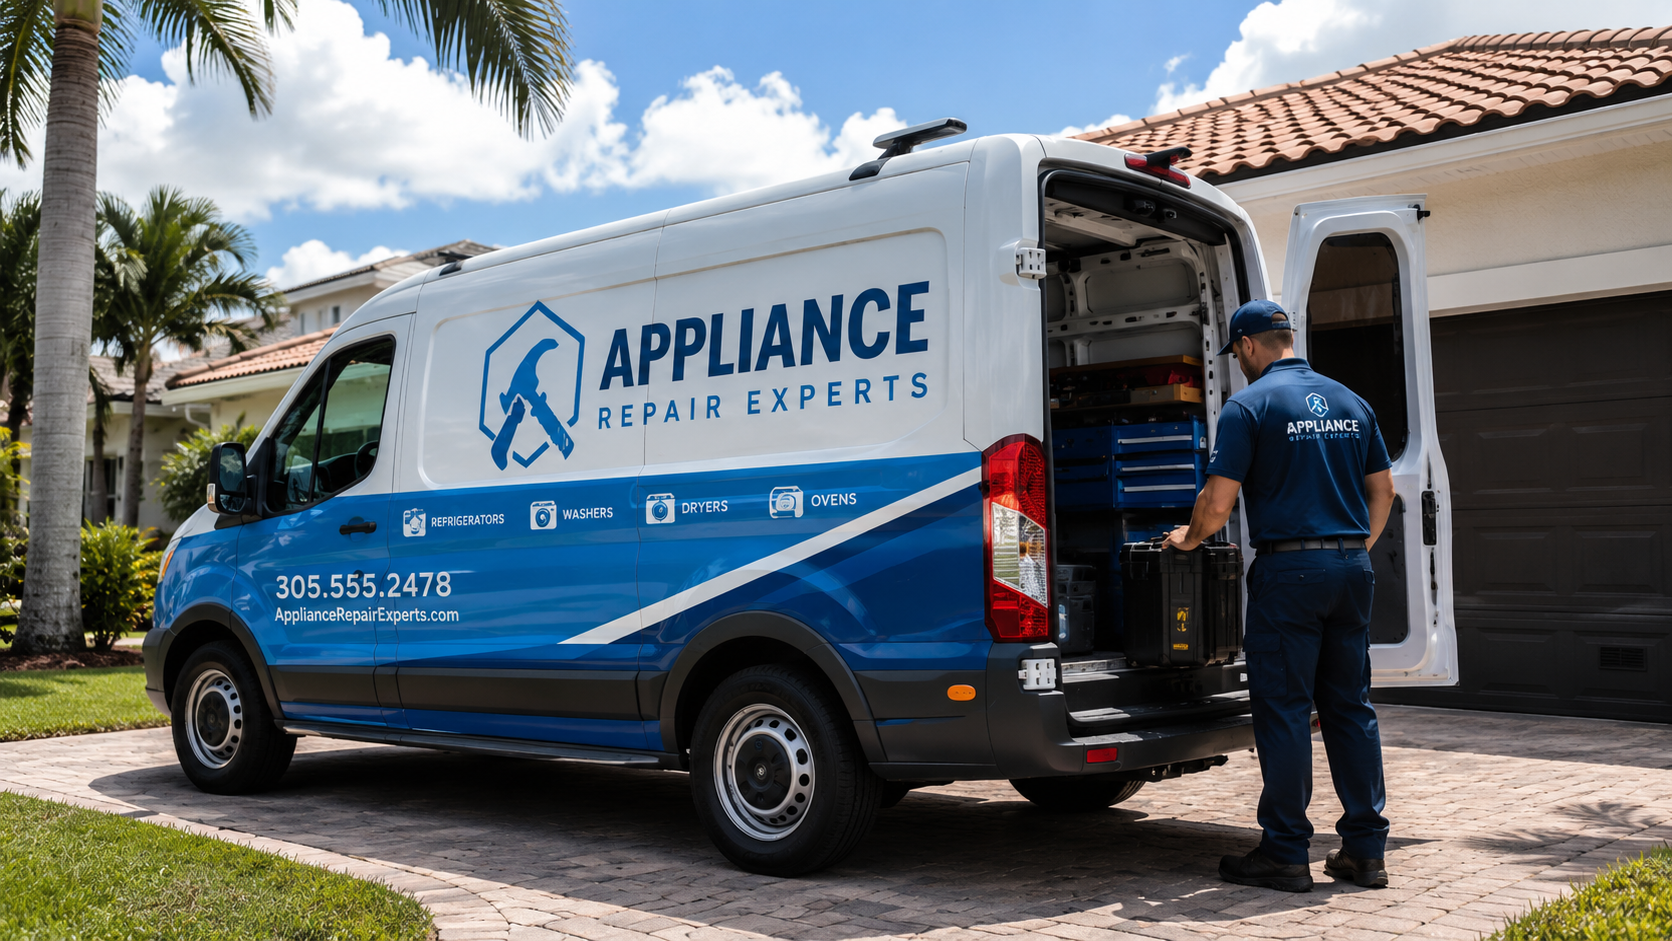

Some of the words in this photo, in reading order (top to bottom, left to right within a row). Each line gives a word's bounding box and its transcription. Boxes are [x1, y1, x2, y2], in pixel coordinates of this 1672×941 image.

[599, 281, 930, 390] APPLIANCE
[598, 395, 721, 429] REPAIR
[747, 372, 928, 415] EXPERTS
[1287, 419, 1359, 434] APPLIANCE
[681, 500, 728, 514] DRYERS
[810, 492, 857, 507] OVENS
[431, 513, 504, 527] REFRIGERATORS
[562, 507, 614, 520] WASHERS
[275, 572, 452, 598] 305.555.2478
[274, 606, 459, 625] ApplianceRepairExperts.com
